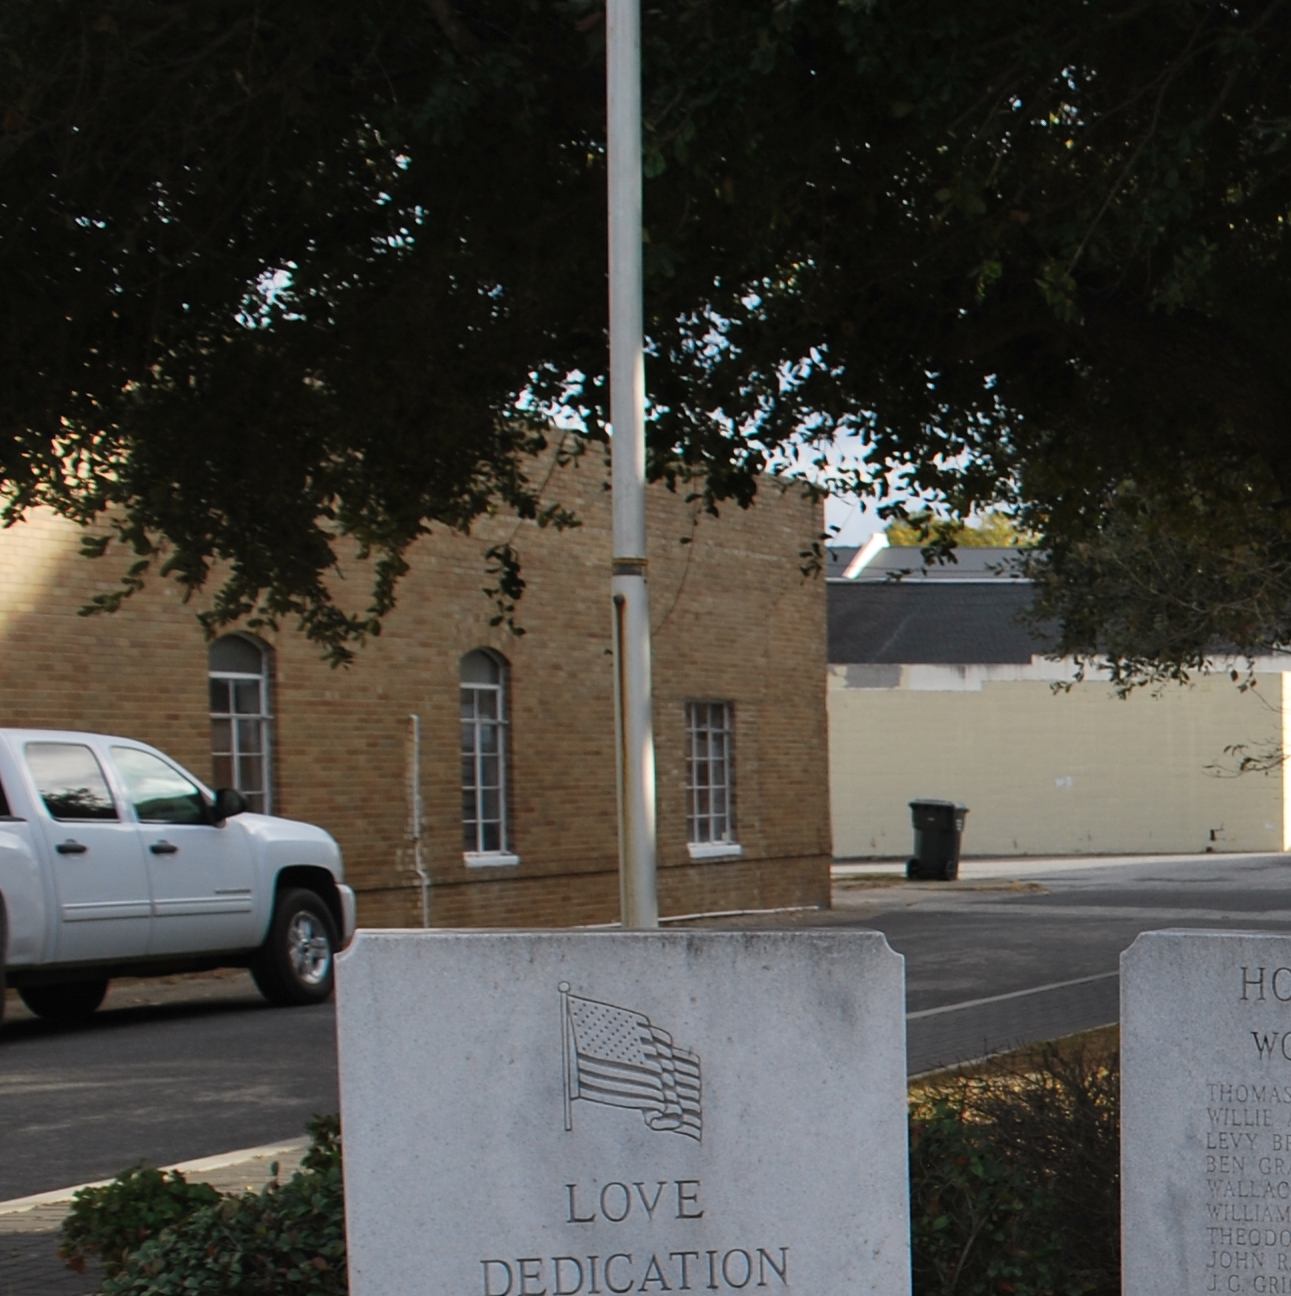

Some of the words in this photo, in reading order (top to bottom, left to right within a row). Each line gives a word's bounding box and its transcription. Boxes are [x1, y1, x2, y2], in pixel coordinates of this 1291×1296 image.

[1207, 1109, 1272, 1127] WILLIE
[1206, 1133, 1257, 1150] LEVY
[1206, 1156, 1245, 1174] BEN
[565, 1179, 705, 1225] LOVE
[1207, 1204, 1290, 1223] WILLIAM
[1206, 1251, 1264, 1270] JOHN
